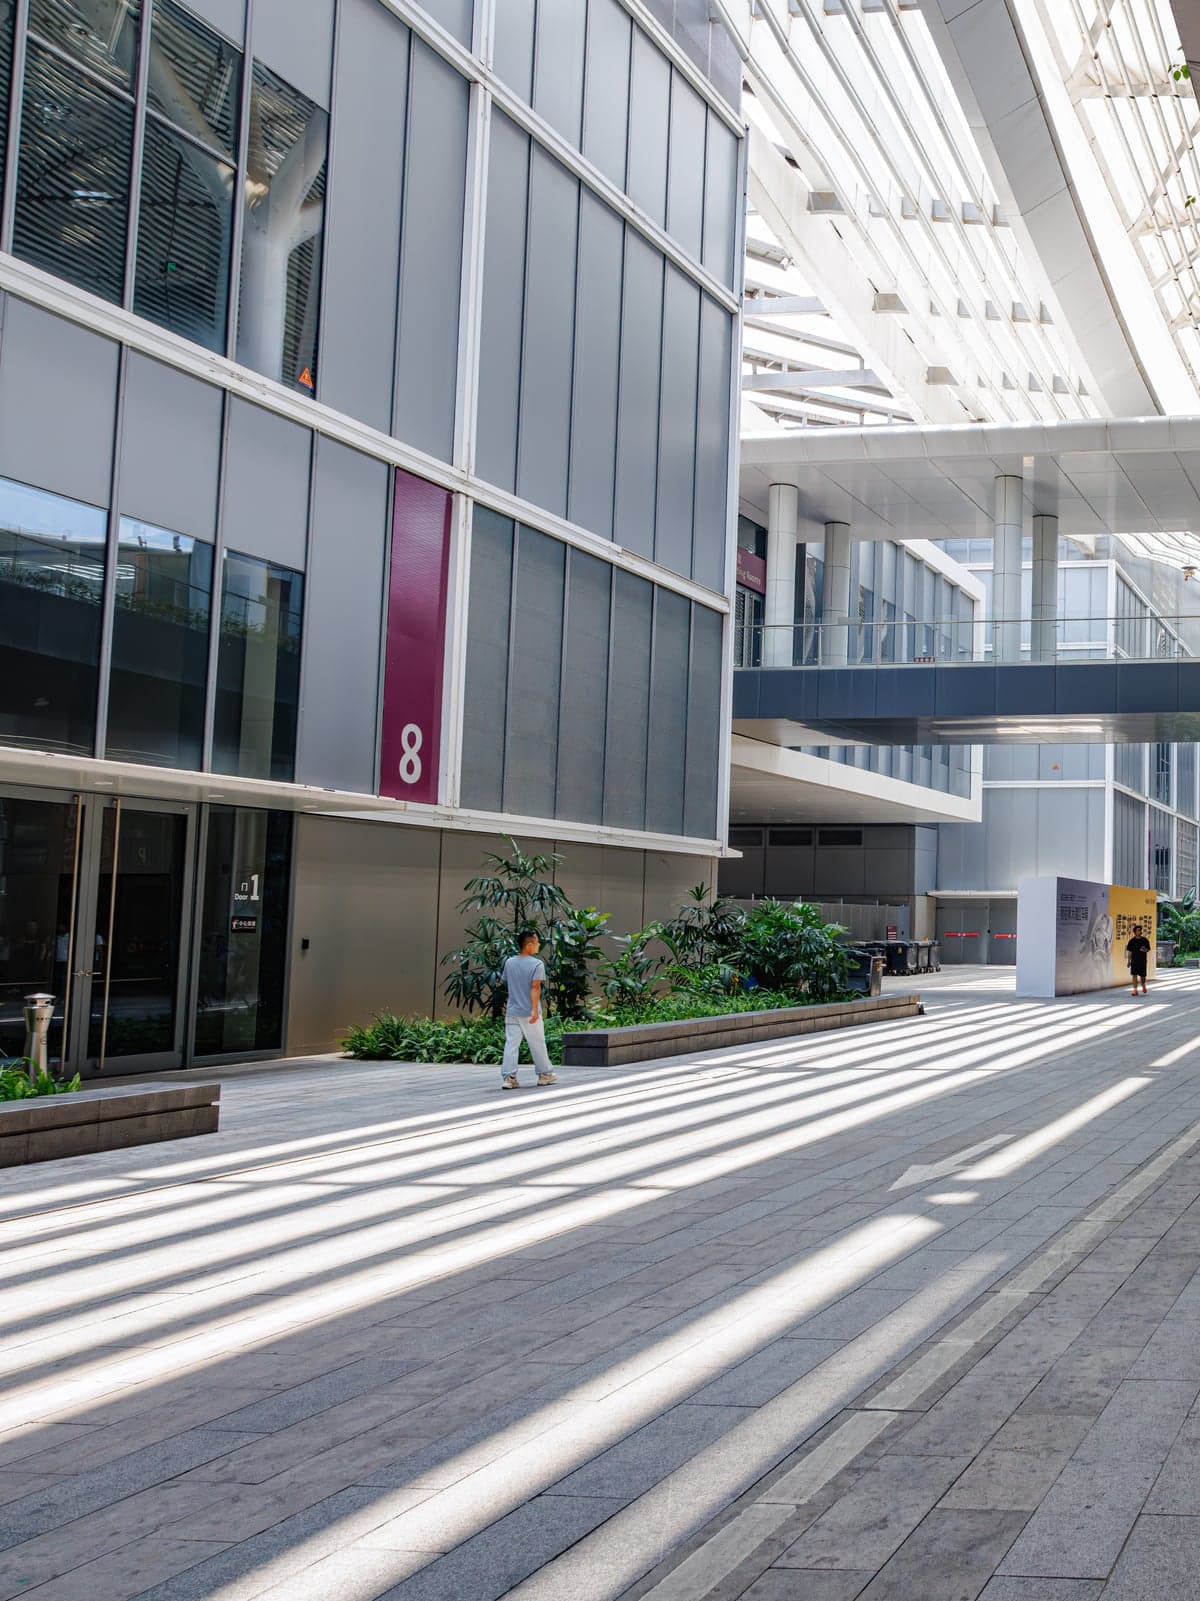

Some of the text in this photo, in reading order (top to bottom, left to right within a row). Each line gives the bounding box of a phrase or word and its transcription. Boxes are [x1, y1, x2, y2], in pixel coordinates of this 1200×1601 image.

[399, 723, 422, 783] 8
[235, 893, 248, 901] Door
[251, 874, 259, 901] 1
